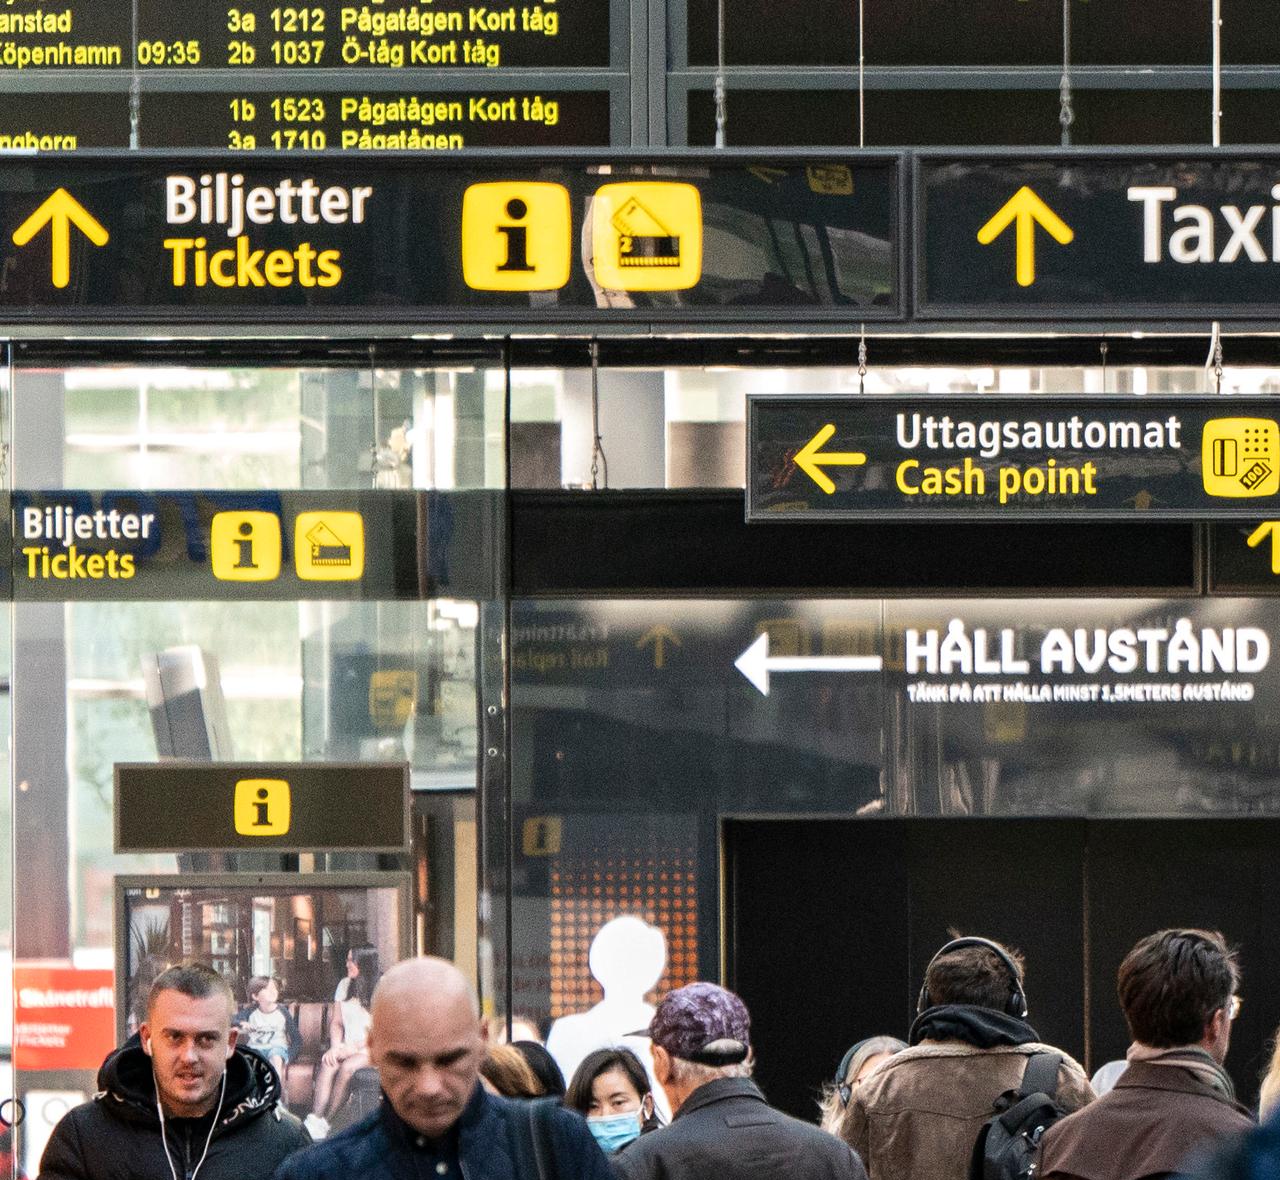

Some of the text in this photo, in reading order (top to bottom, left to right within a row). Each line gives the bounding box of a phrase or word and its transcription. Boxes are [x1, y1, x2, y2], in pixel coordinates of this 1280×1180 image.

[228, 9, 256, 32] 3a
[272, 8, 325, 32] 1212
[341, 7, 462, 35] Pågatågen
[469, 8, 515, 31] Kort
[522, 6, 558, 35] tåg
[138, 40, 200, 64] 09:35
[228, 41, 255, 64] 2b
[272, 41, 324, 64] 1037
[342, 36, 404, 68] Ö-tåg
[411, 40, 457, 63] Kort
[463, 39, 499, 68] tåg
[230, 96, 558, 125] 1b 1523 Pågatågen Kort tåg
[229, 130, 255, 150] 3a
[272, 130, 326, 150] 1710
[342, 131, 463, 150] Pågatågen
[165, 174, 371, 235] Biljetter
[164, 236, 341, 286] Tickets
[897, 413, 1180, 456] Uttagsautomat
[896, 458, 1096, 503] Cash point
[24, 506, 154, 544] Biljetter
[24, 546, 134, 578] Tickets
[905, 618, 1270, 674] HÅLL AVSTÅND
[907, 682, 948, 702] TÄNK
[950, 682, 972, 702] PÅ
[973, 684, 1002, 702] ATT
[1003, 683, 1050, 702] HÅLLA
[1051, 684, 1100, 701] MINST
[1183, 681, 1254, 701] AVSTÅND
